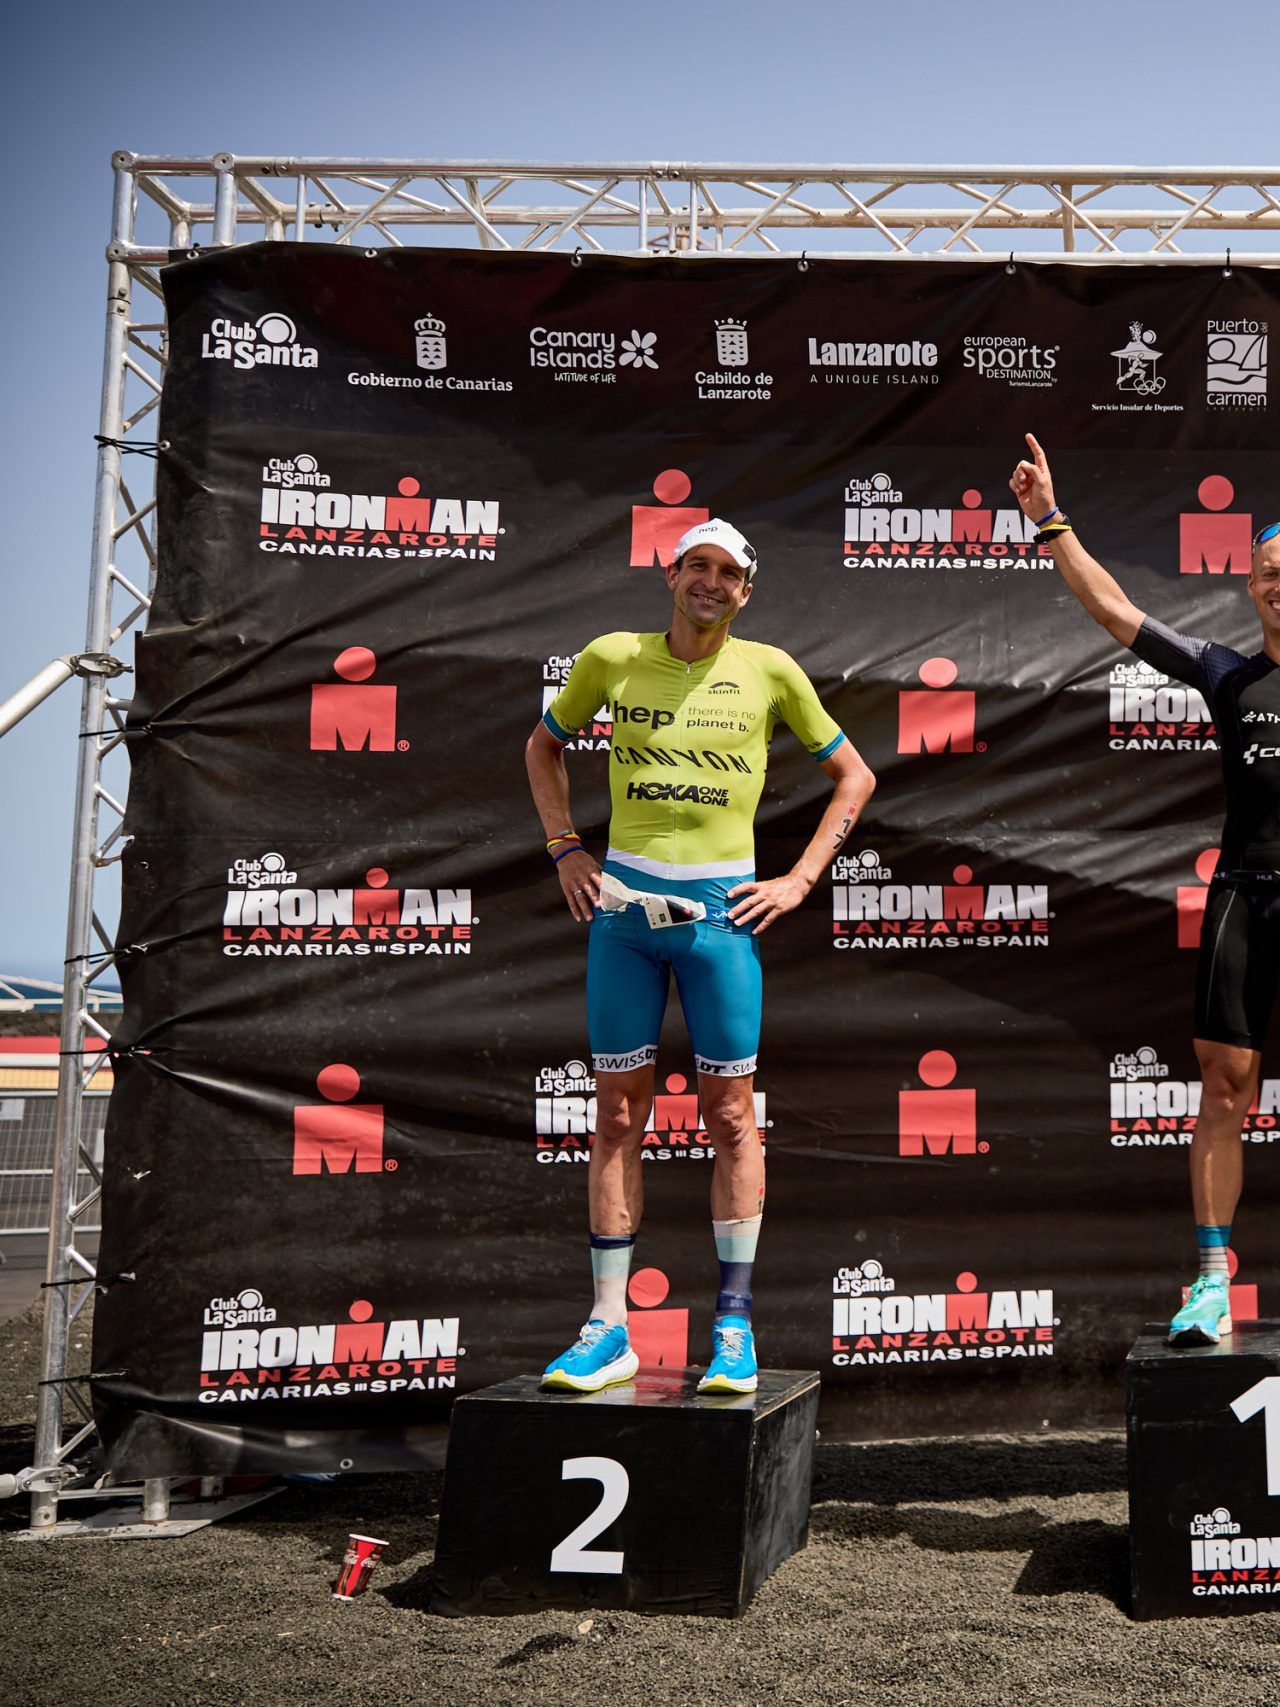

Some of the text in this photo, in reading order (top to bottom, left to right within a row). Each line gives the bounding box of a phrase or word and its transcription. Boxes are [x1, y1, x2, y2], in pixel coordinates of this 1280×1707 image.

[212, 318, 256, 342] Club
[530, 327, 615, 353] Canary
[964, 336, 1025, 349] european
[531, 347, 615, 368] Islands
[809, 338, 937, 366] Lanzarote
[963, 346, 1056, 374] sports
[554, 373, 587, 382] LATITUDE
[602, 374, 616, 383] LIFE
[695, 372, 773, 385] Cabildo de
[810, 374, 939, 384] A UNIQUE ISLAND
[987, 368, 1050, 379] DESTINATION
[348, 372, 513, 391] Gobierno de Canarias
[699, 388, 771, 399] Lanzarote
[1206, 393, 1267, 406] carmen
[1092, 403, 1183, 412] Servicio Insular de Deportes
[269, 459, 294, 471] Club
[850, 479, 871, 490] Club
[261, 488, 499, 534] IRONMAN
[260, 525, 496, 547] LANZAROTE
[259, 540, 495, 561] CANARIAS SPAIN
[844, 543, 1052, 555] LANZAROTE
[844, 557, 1054, 570] CANARIAS SPAIN
[549, 656, 572, 667] Club
[1115, 663, 1137, 675] Club
[614, 701, 675, 729] hep
[688, 707, 755, 720] there is no
[687, 719, 734, 730] planet
[615, 746, 752, 774] CANYON
[627, 782, 728, 803] HOKA ONE
[700, 796, 729, 806] ONE
[234, 859, 261, 871] Club
[837, 856, 859, 868] Club
[223, 889, 471, 926] IRONMAN
[833, 885, 1048, 920] IRONMAN
[223, 926, 471, 941] LANZAROTE
[833, 920, 1048, 934] LANZAROTE
[223, 942, 471, 956] CANARIAS SPAIN
[833, 935, 1048, 949] CANARIAS SPAIN
[599, 1051, 644, 1069] SWISS
[1115, 1054, 1137, 1065] Club
[541, 1068, 565, 1079] Club
[700, 1064, 727, 1074] DT
[838, 1268, 862, 1279] Club
[210, 1298, 238, 1311] Club
[832, 1289, 1053, 1336] IRONMAN
[201, 1318, 459, 1371] IRONMAN
[832, 1328, 1053, 1350] LANZAROTE
[832, 1344, 1053, 1367] CANARIAS SPAIN
[200, 1358, 456, 1387] LANZAROTE
[199, 1376, 455, 1403] CANARIAS SPAIN
[551, 1456, 630, 1574] 2
[1194, 1514, 1214, 1525] Club
